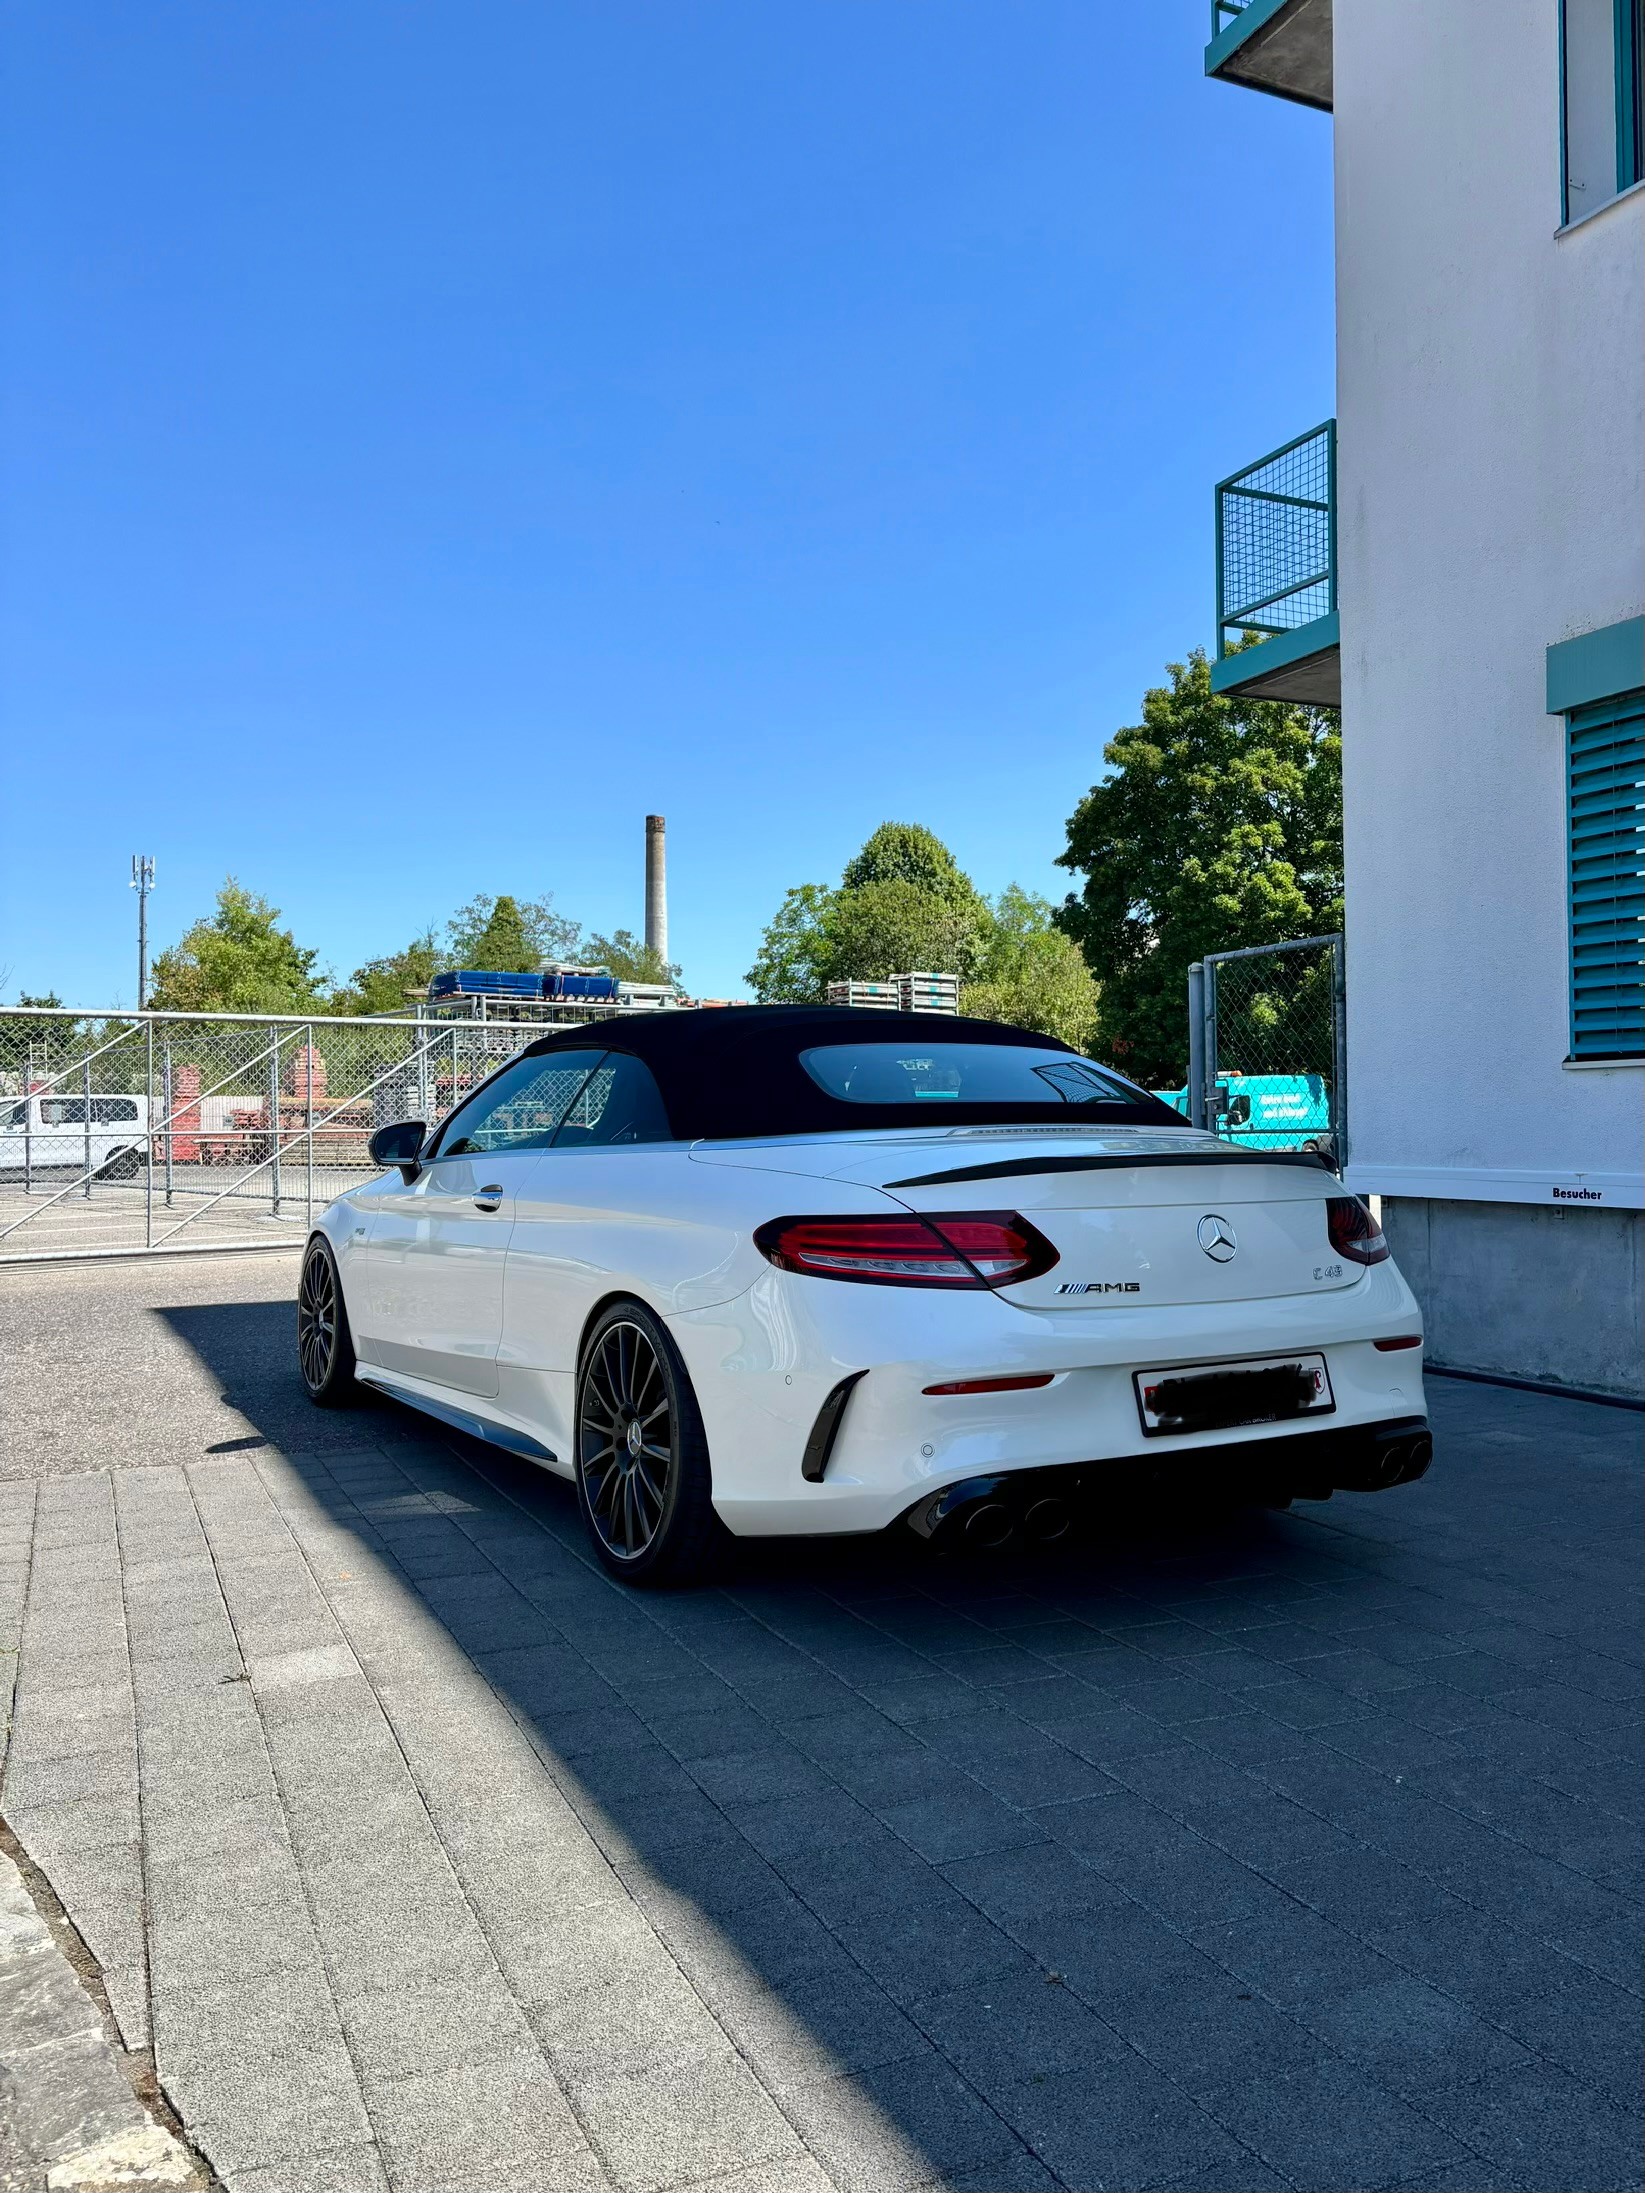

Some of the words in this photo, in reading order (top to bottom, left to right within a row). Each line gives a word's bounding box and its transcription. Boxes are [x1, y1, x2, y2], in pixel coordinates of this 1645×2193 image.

[1552, 1187, 1602, 1200] Besucher
[1313, 1268, 1323, 1281] C
[1325, 1264, 1343, 1279] 43
[1080, 1282, 1141, 1293] AMG
